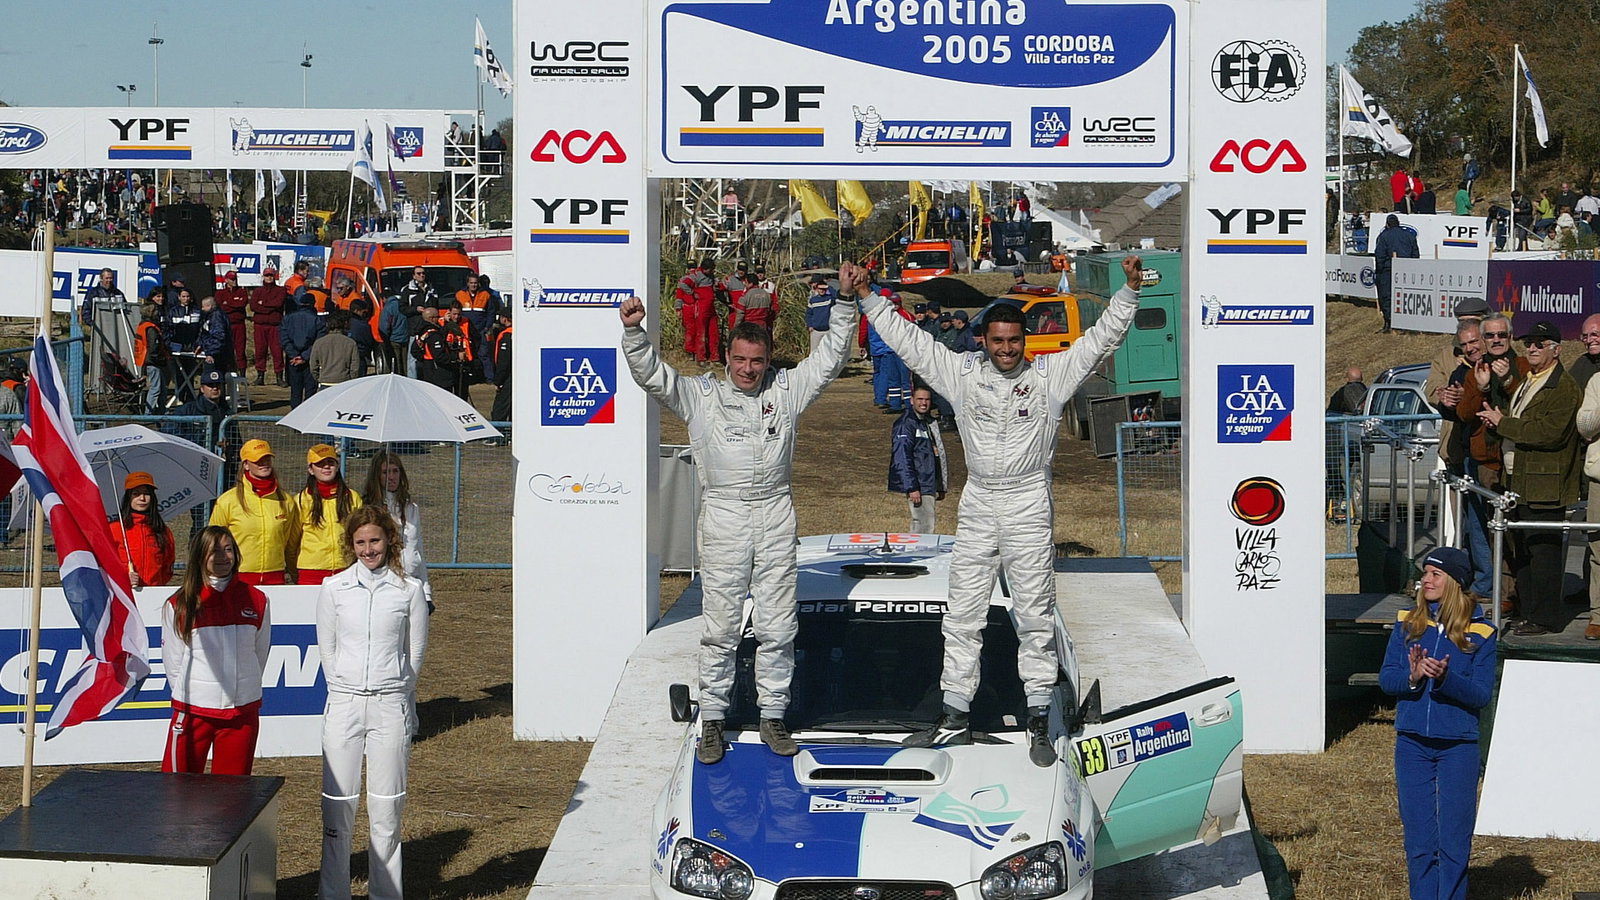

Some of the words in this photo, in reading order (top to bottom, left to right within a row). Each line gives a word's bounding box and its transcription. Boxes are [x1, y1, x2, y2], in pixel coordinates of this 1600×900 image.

[825, 0, 1026, 32] Argentina
[531, 41, 629, 61] WRC
[922, 35, 1012, 64] 2005
[1024, 35, 1115, 52] CORDOBA
[1024, 53, 1050, 64] Villa
[1053, 53, 1090, 64] Carlos
[1093, 54, 1115, 64] Paz
[681, 85, 825, 122] YPF
[1043, 112, 1060, 121] LA
[108, 118, 190, 141] YPF
[1034, 121, 1067, 133] CAJA
[1083, 117, 1155, 131] WRC
[255, 134, 352, 145] MICHELIN
[885, 126, 1007, 140] MICHELIN
[530, 129, 627, 164] ACA
[1209, 138, 1307, 174] ACA
[531, 198, 629, 225] YPF
[1207, 208, 1307, 234] YPF
[1445, 225, 1479, 239] YPF
[1394, 272, 1434, 286] GRUPO
[1440, 275, 1483, 288] GRUPO
[545, 293, 631, 303] MICHELIN
[1403, 293, 1433, 316] ECIPSA
[1520, 285, 1583, 314] Multicanal
[1224, 309, 1311, 319] MICHELIN
[564, 358, 596, 376] LA
[548, 375, 609, 398] CAJA
[1240, 375, 1274, 392] LA
[549, 397, 560, 406] de
[562, 397, 595, 407] ahorro
[1225, 392, 1286, 415] CAJA
[335, 410, 374, 423] YPF
[455, 413, 477, 425] YPF
[549, 408, 556, 418] y
[557, 409, 587, 418] seguro
[1226, 414, 1237, 424] de
[1239, 414, 1272, 424] ahorro
[1226, 425, 1233, 435] y
[1234, 425, 1264, 435] seguro
[104, 434, 143, 445] ECCO
[1235, 527, 1281, 551] VILLA
[1235, 551, 1281, 576] CARLOS
[796, 602, 848, 613] atar
[1108, 731, 1129, 744] YPF
[1136, 726, 1154, 738] Rally
[1135, 728, 1190, 756] Argentina
[1081, 737, 1106, 775] 33
